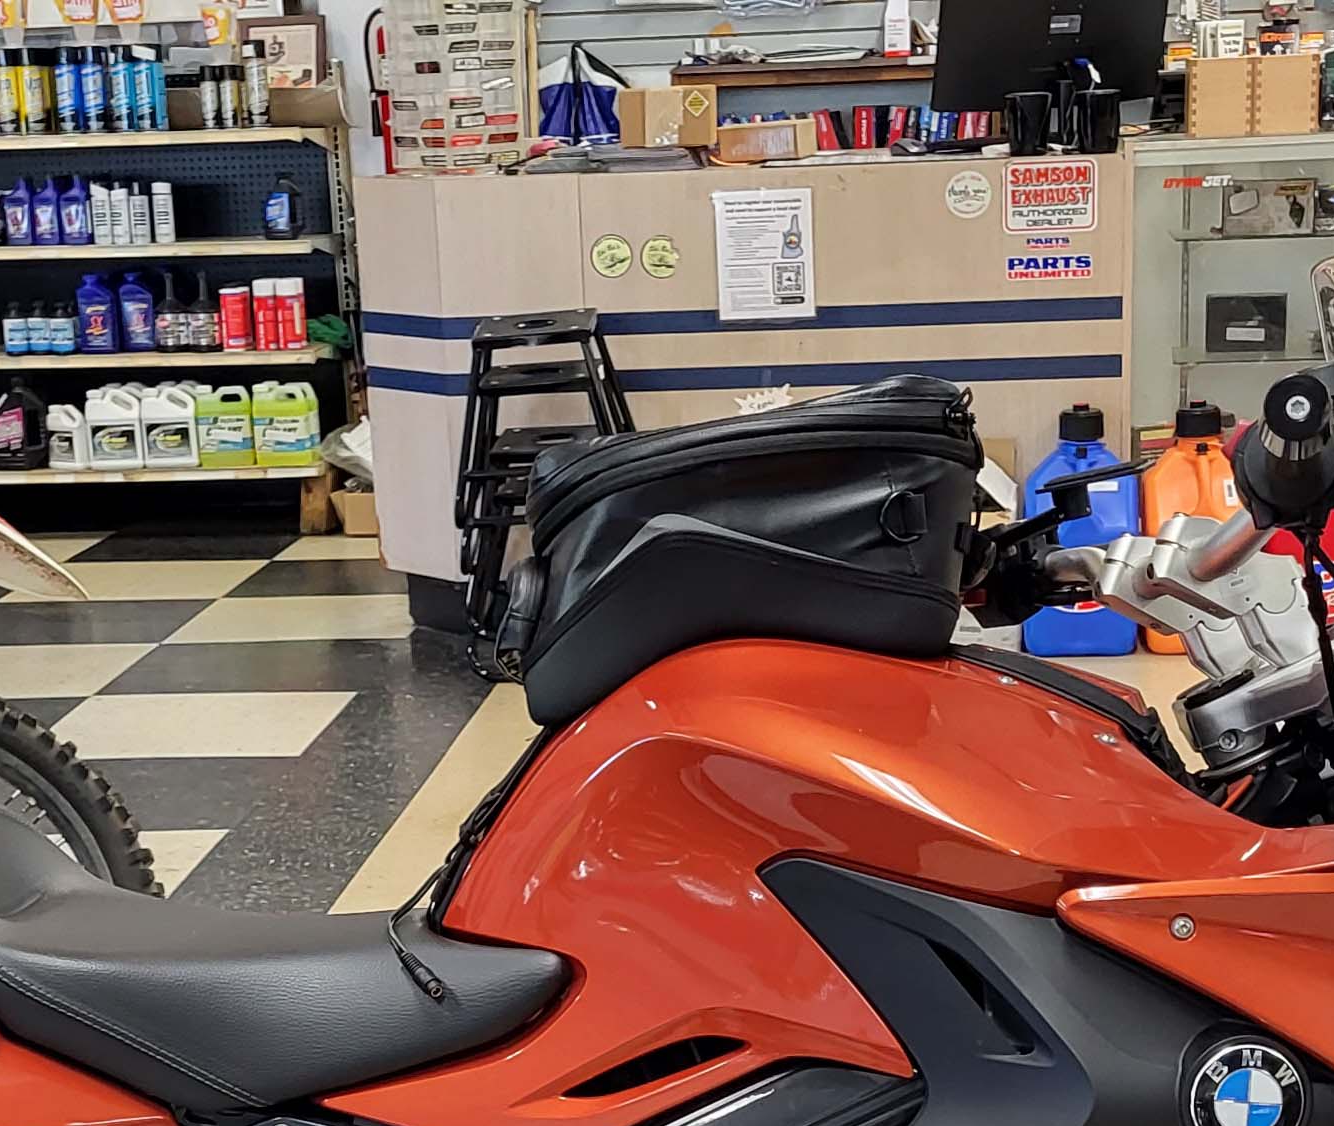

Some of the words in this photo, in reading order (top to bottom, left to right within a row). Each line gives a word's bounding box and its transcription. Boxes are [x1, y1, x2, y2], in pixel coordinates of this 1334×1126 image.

[1010, 166, 1091, 186] SAMSON
[1010, 187, 1092, 207] EXHAUST
[1012, 207, 1087, 217] AUTHORIZED
[1026, 218, 1073, 227] DEALER
[1026, 237, 1070, 245] PARTS
[1008, 255, 1092, 270] PARTS
[1008, 269, 1092, 279] UNLIMITED
[1205, 1048, 1297, 1087] BMW
